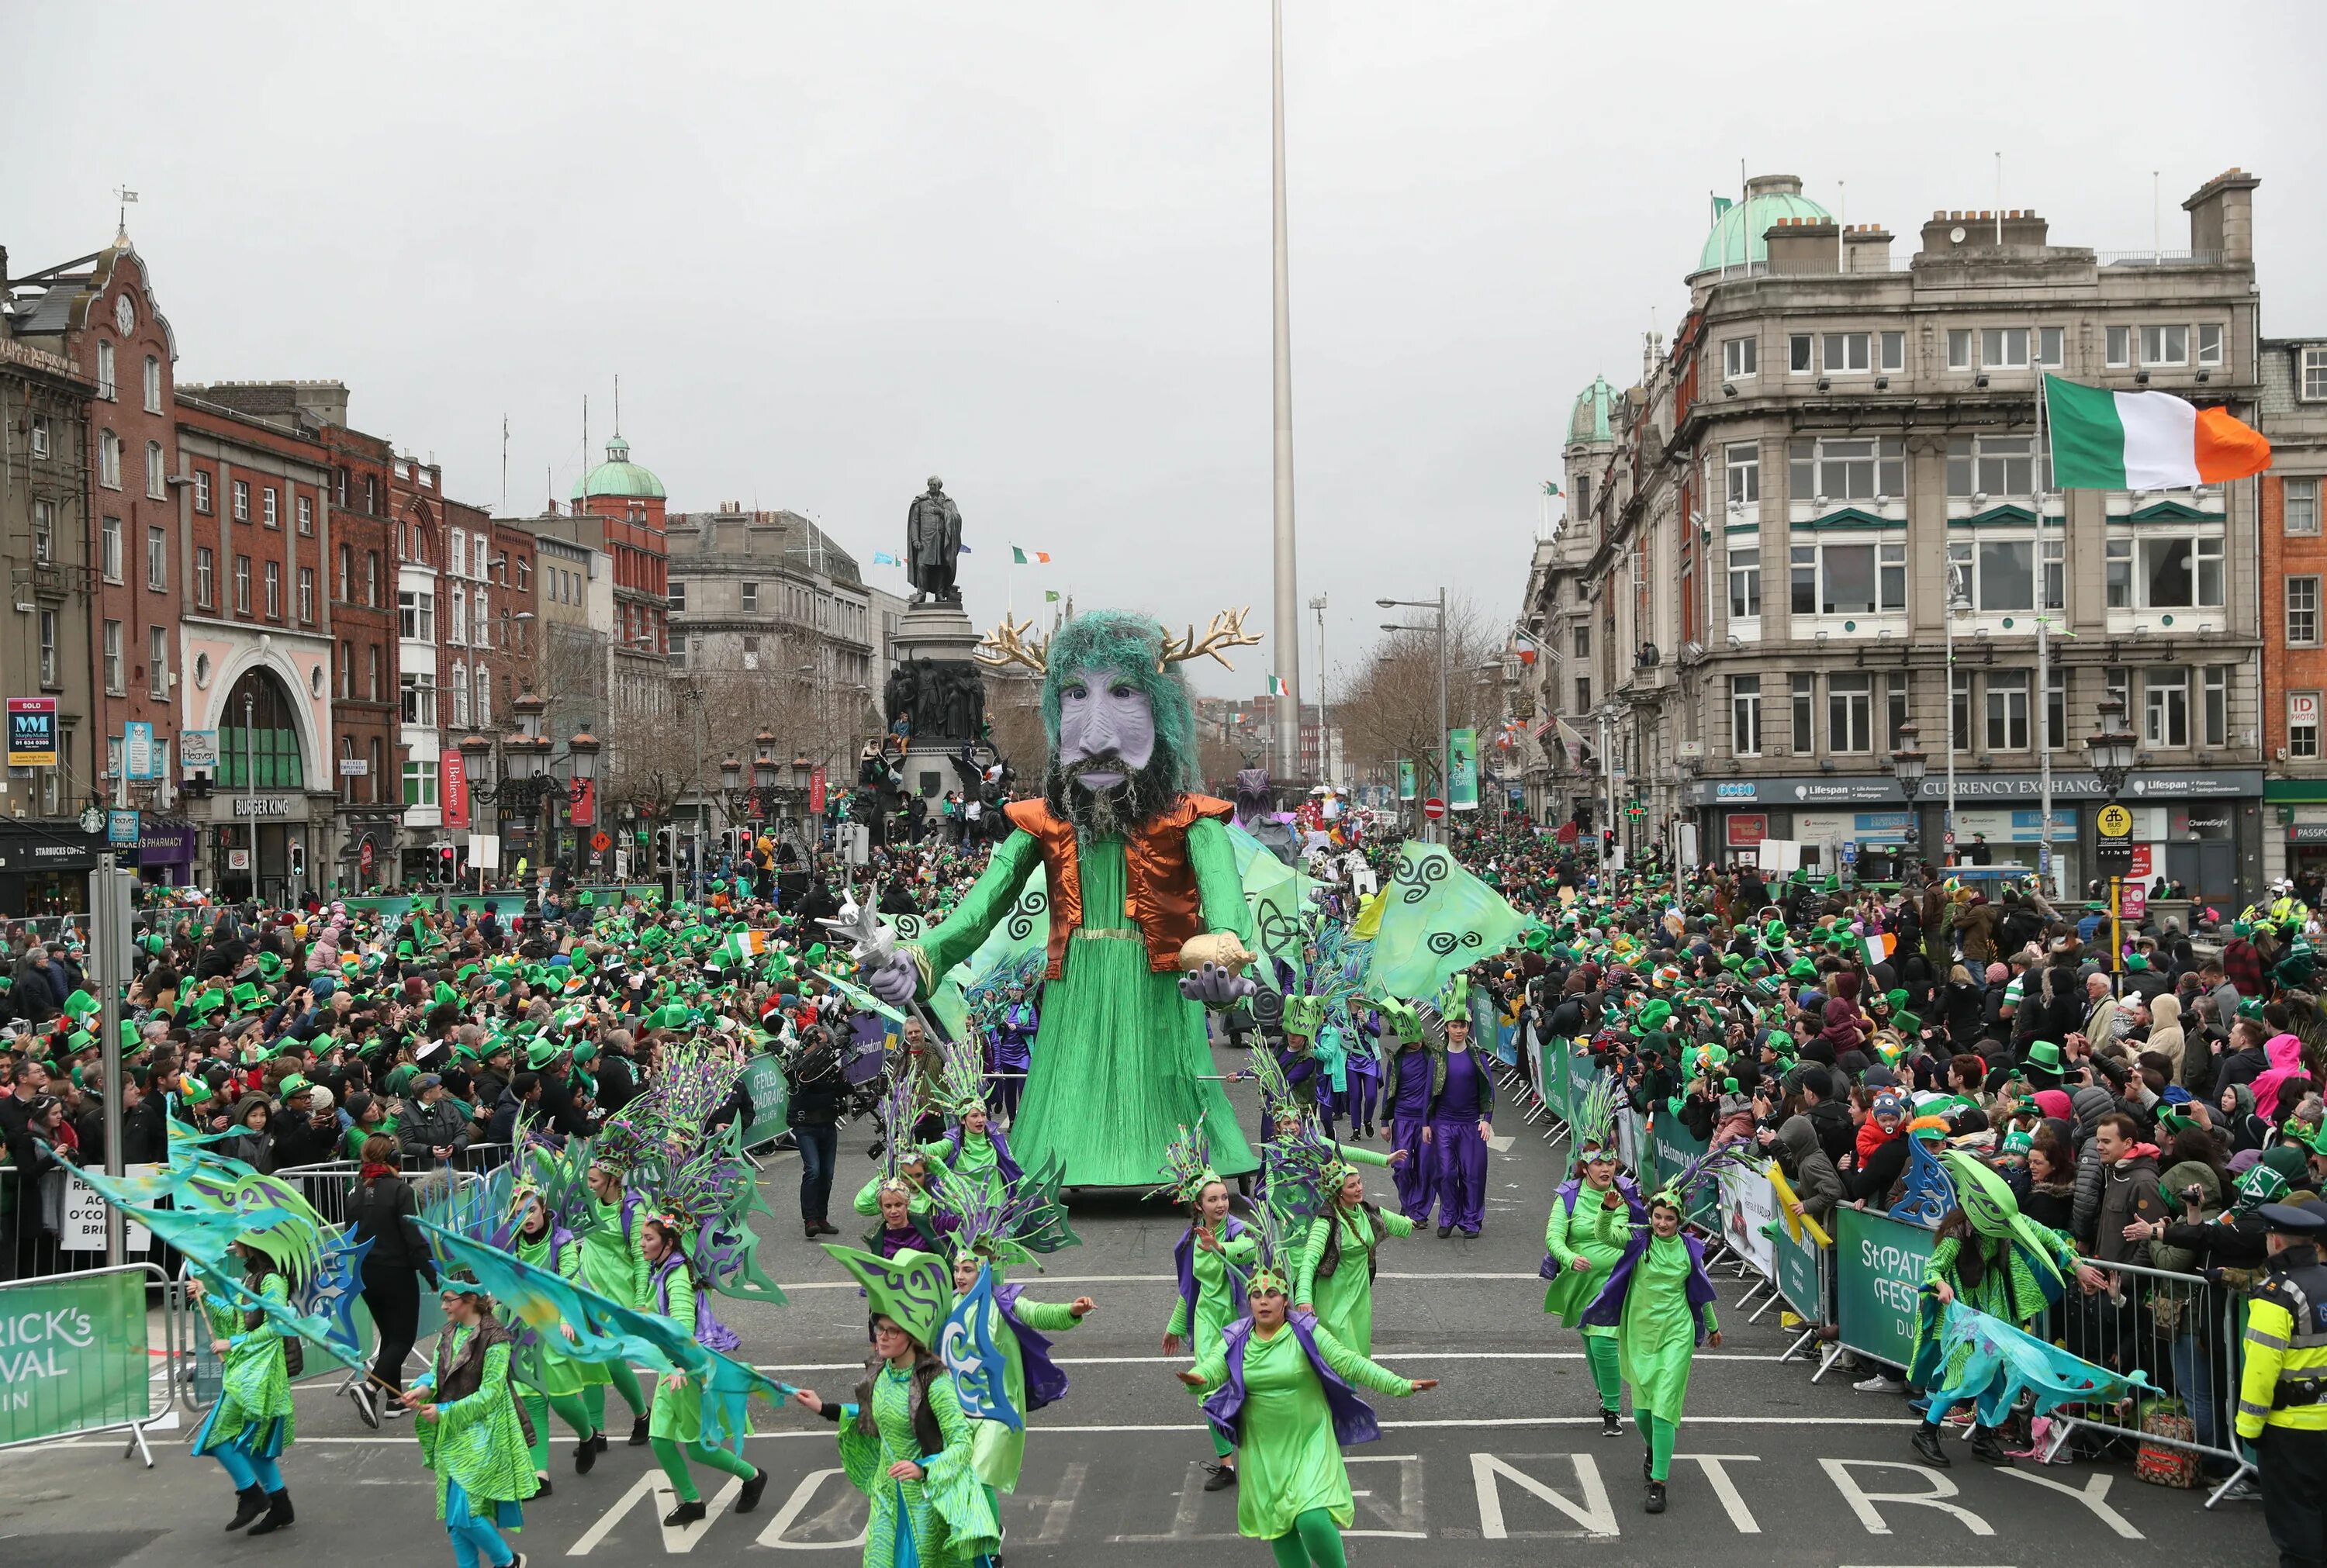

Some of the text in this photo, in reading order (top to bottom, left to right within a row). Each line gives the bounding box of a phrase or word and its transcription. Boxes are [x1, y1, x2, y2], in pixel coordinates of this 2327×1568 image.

[2294, 699, 2312, 711] ID
[182, 748, 216, 763] Heaven
[1810, 786, 1848, 795] Lifespan
[1923, 779, 2108, 795] CURRENCY EXCHANG
[2148, 780, 2187, 790] Lifespan
[269, 799, 289, 814] KING
[110, 813, 137, 827] Heaven
[2188, 819, 2229, 828] ChannelSight
[147, 838, 182, 847] PHARMACY
[35, 847, 66, 856] STARBUCKS
[753, 1069, 776, 1090] FÉILE
[762, 1109, 777, 1123] CLIATH
[1656, 1138, 1684, 1166] Welcome
[69, 1210, 107, 1221] O'CO
[82, 1225, 132, 1235] BRIE
[1862, 1239, 1879, 1270] St
[1897, 1318, 1914, 1339] DU
[3, 1390, 29, 1412] IN
